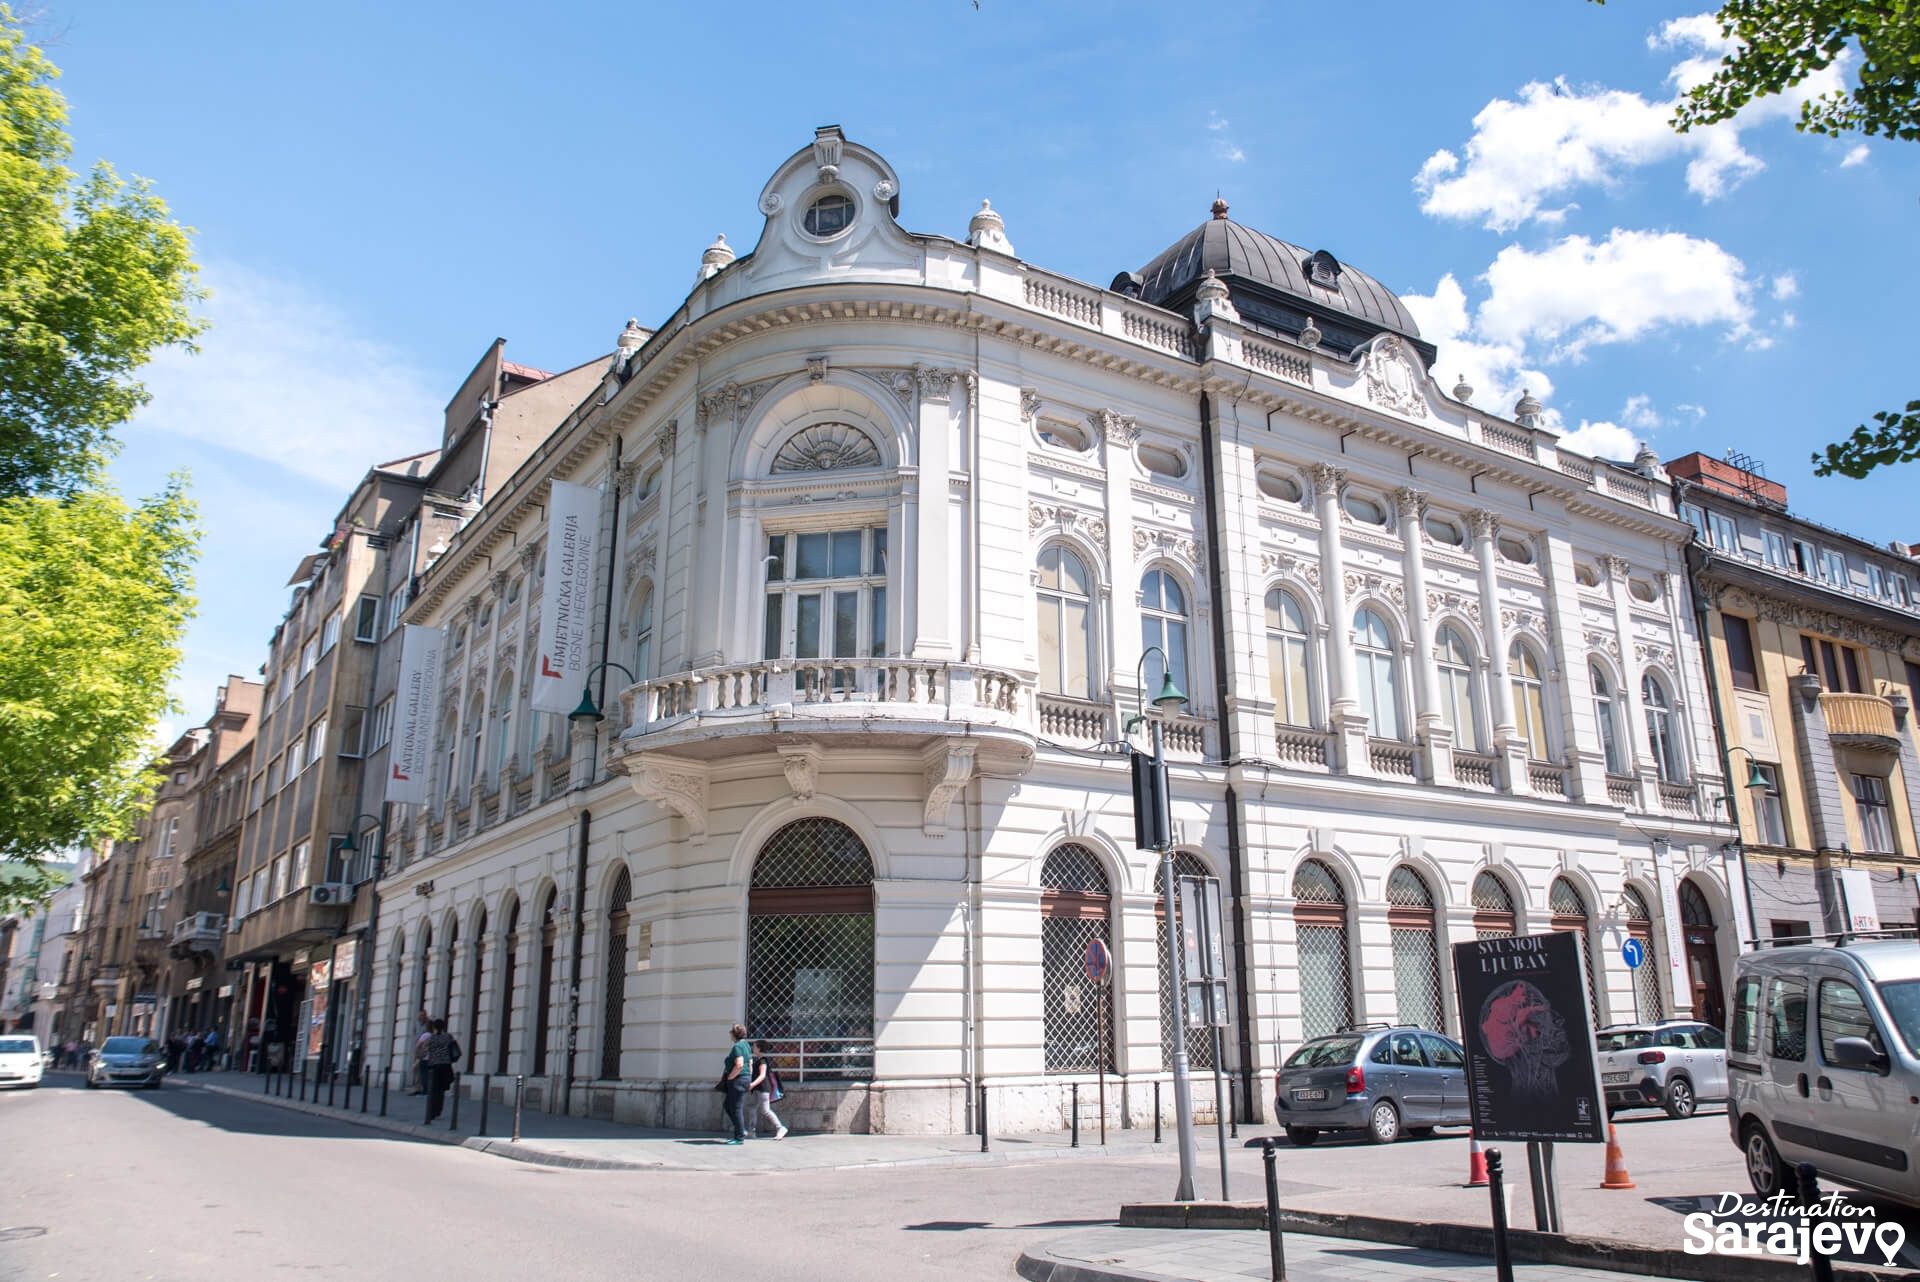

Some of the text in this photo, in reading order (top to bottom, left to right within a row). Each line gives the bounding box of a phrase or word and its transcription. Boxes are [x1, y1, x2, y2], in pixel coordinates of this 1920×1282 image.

[552, 515, 578, 668] UMJETNIČKA GALERIJA
[573, 535, 592, 619] HERCEGOVINE
[569, 629, 584, 672] BOSNE
[401, 671, 422, 773] NATIONAL GALLERY
[1481, 953, 1548, 975] LJUBAV
